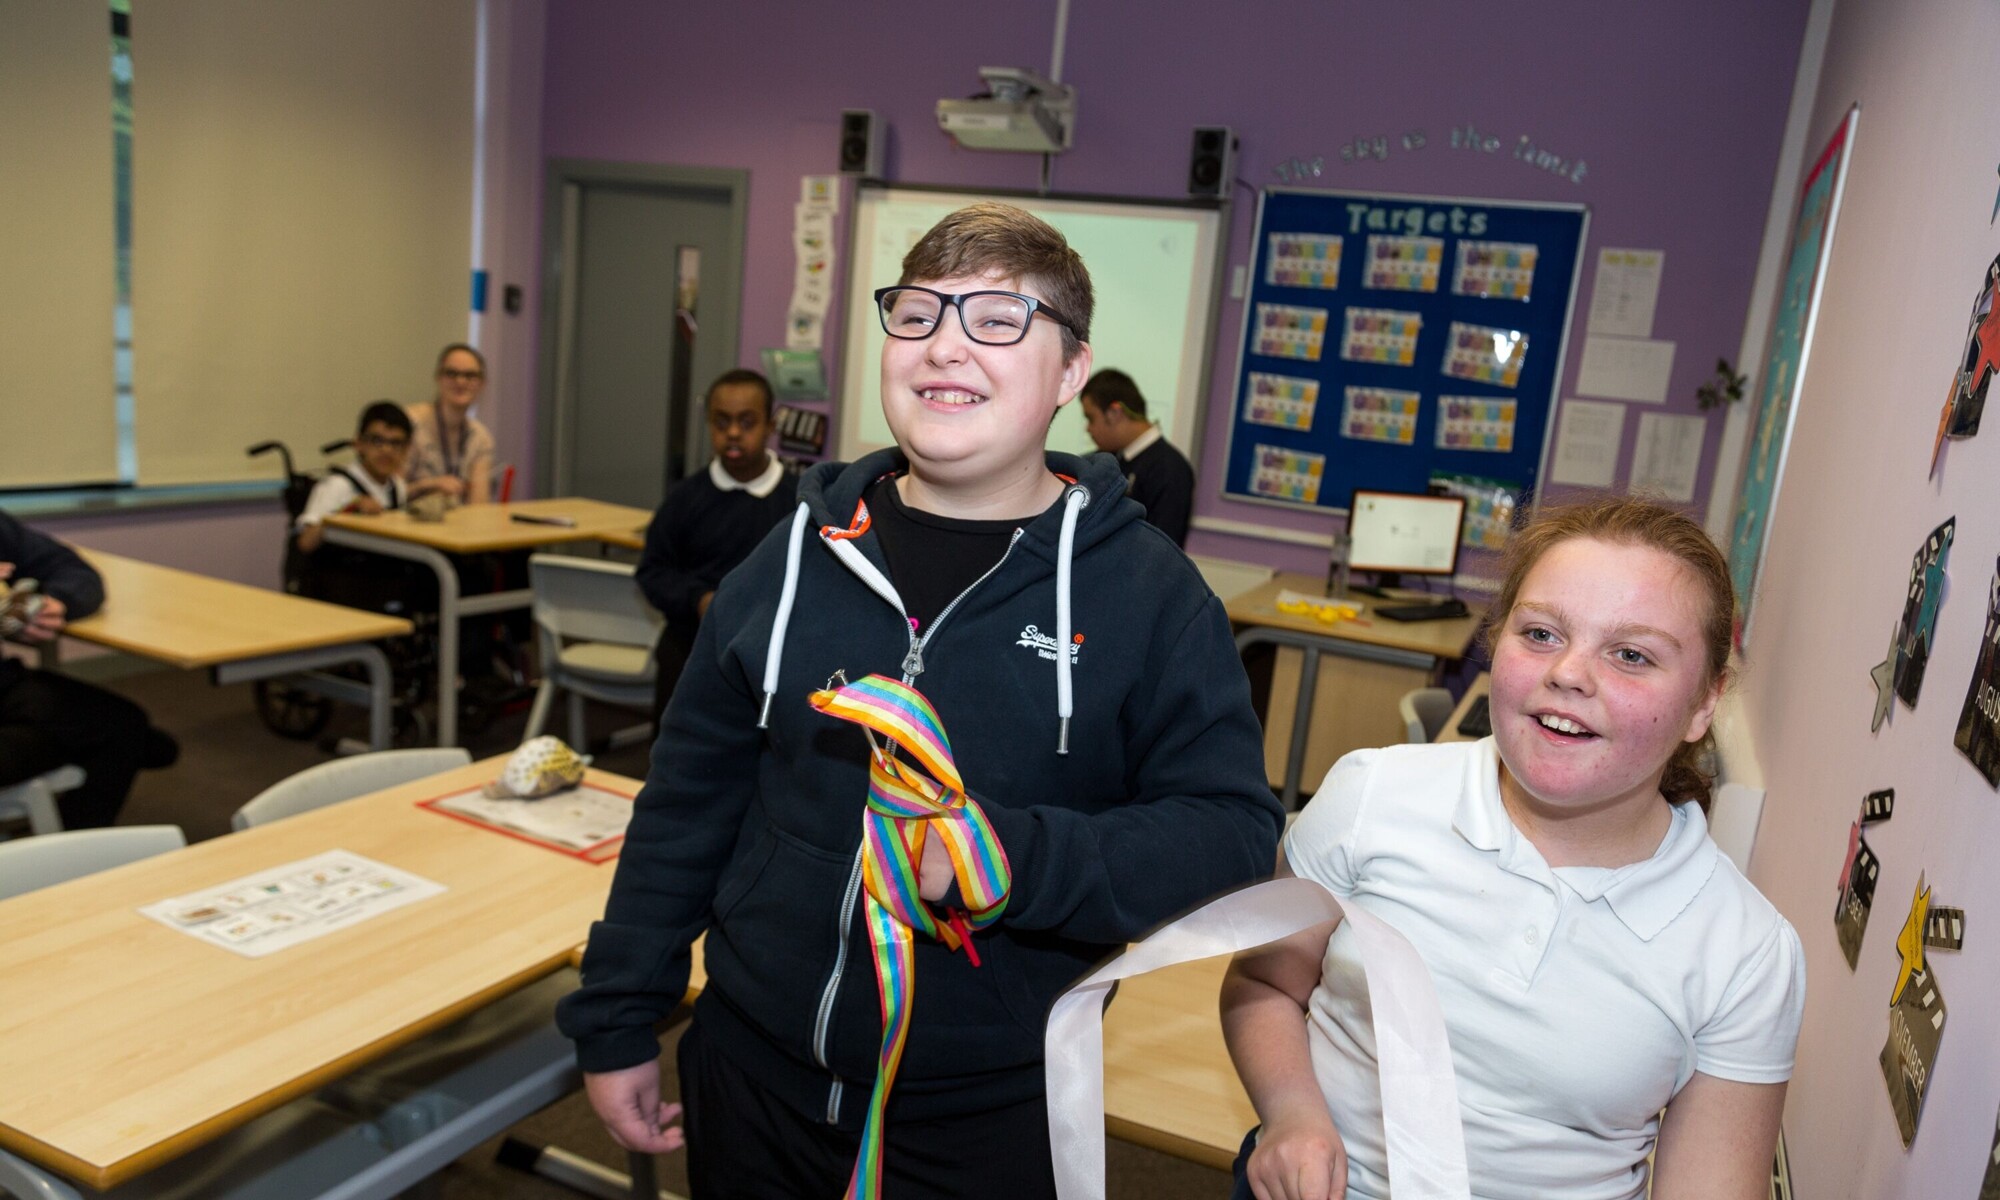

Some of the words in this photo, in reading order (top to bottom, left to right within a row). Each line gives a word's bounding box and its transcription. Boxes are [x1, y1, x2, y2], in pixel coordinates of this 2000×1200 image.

[1274, 156, 1325, 183] The
[1340, 136, 1389, 161] sky
[1450, 126, 1501, 153] the
[1346, 203, 1488, 236] Targets
[1891, 1005, 1926, 1100] NOVEMBER
